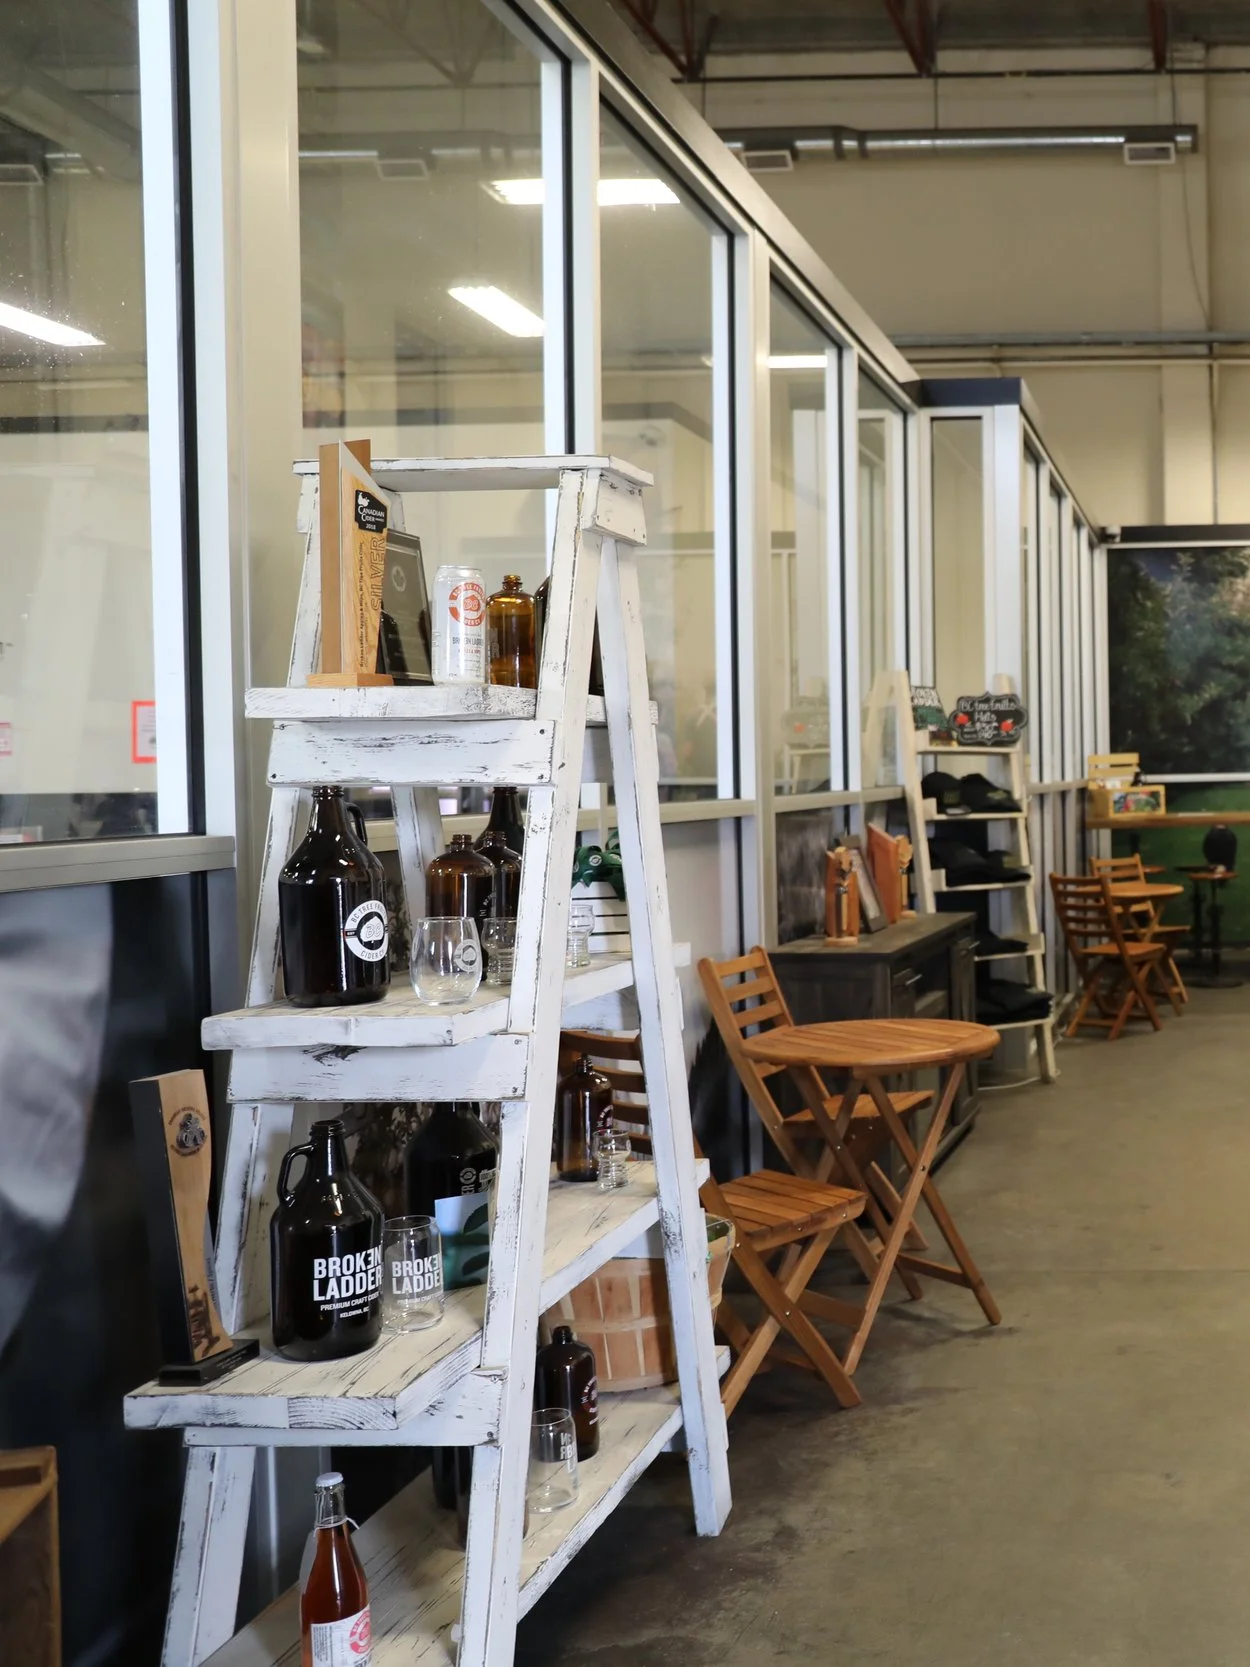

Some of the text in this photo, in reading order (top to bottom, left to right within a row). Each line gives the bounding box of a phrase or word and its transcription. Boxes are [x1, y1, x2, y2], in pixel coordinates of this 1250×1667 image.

[357, 505, 385, 518] CANADIAN
[370, 536, 386, 611] SILVER
[358, 904, 373, 914] TREE
[361, 950, 378, 960] CIDER
[313, 1245, 381, 1279] BROKEN
[313, 1265, 382, 1301] LADDER
[320, 1301, 351, 1311] PREMIUM
[351, 1296, 368, 1306] CRAFT
